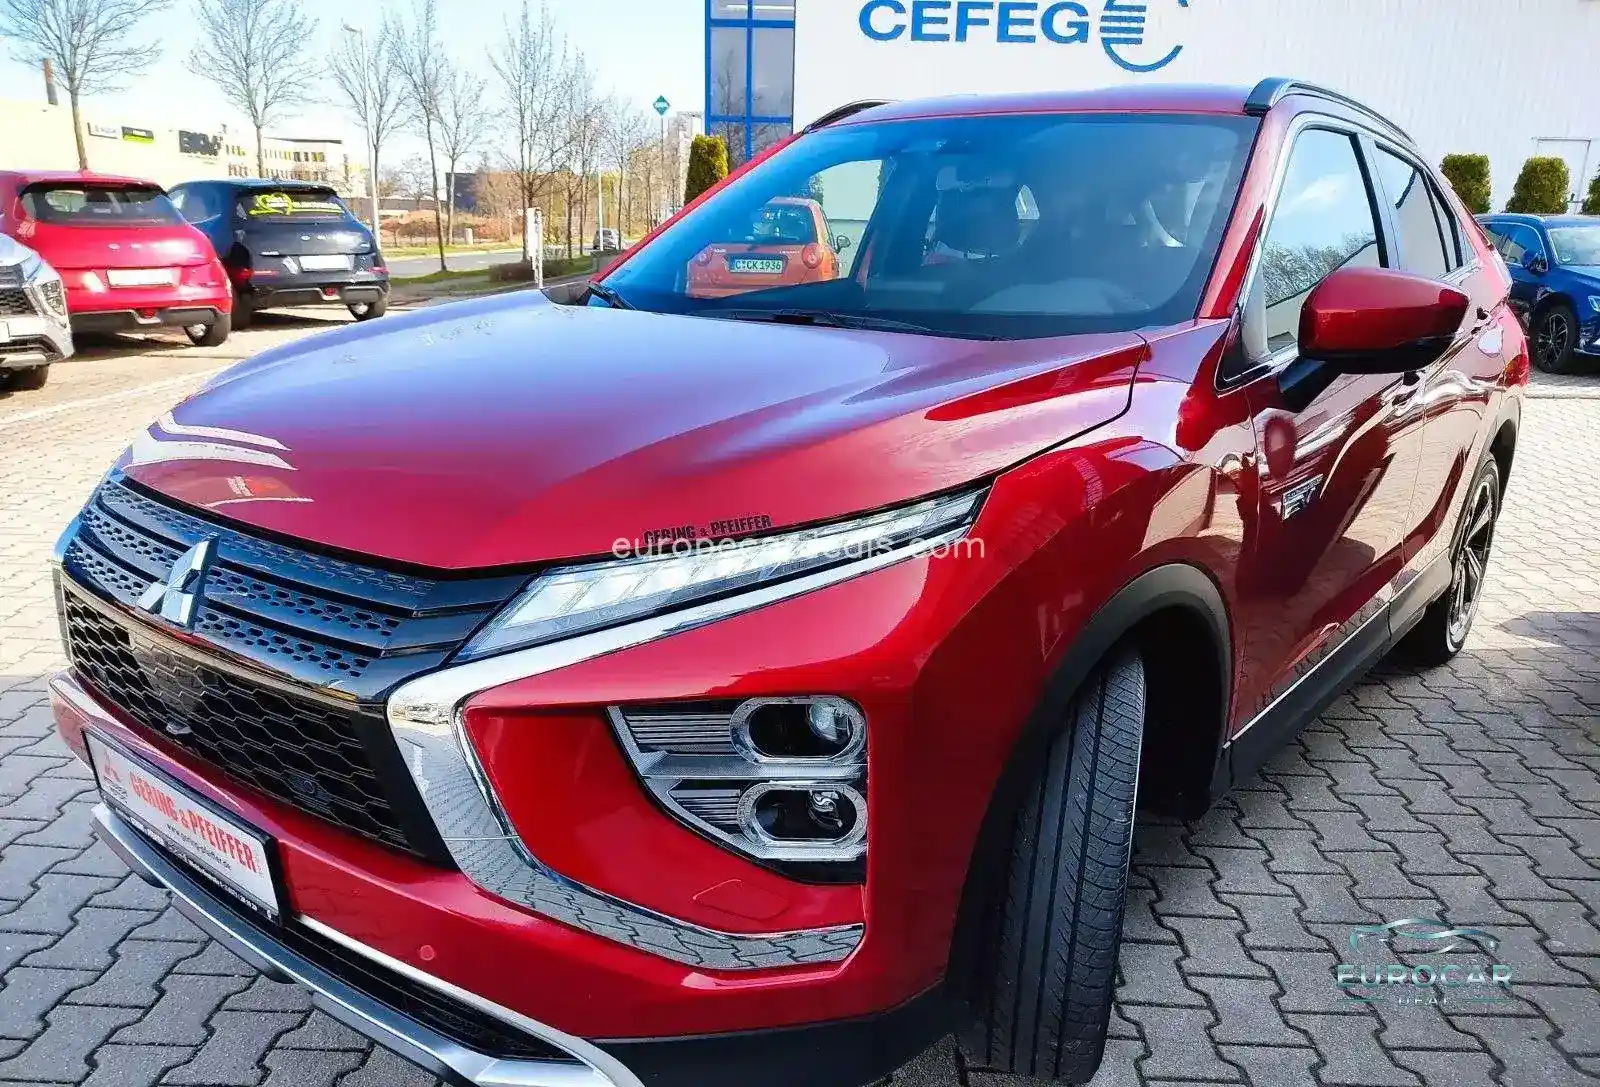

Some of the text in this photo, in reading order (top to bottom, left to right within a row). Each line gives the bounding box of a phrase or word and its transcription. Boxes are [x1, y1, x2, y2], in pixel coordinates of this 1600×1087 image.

[858, 0, 1090, 44] CEFEG
[699, 526, 709, 537] &
[710, 514, 772, 536] PFEIFFER
[129, 770, 178, 822] GERING
[178, 808, 189, 829] &
[187, 808, 258, 875] PFEIFFER
